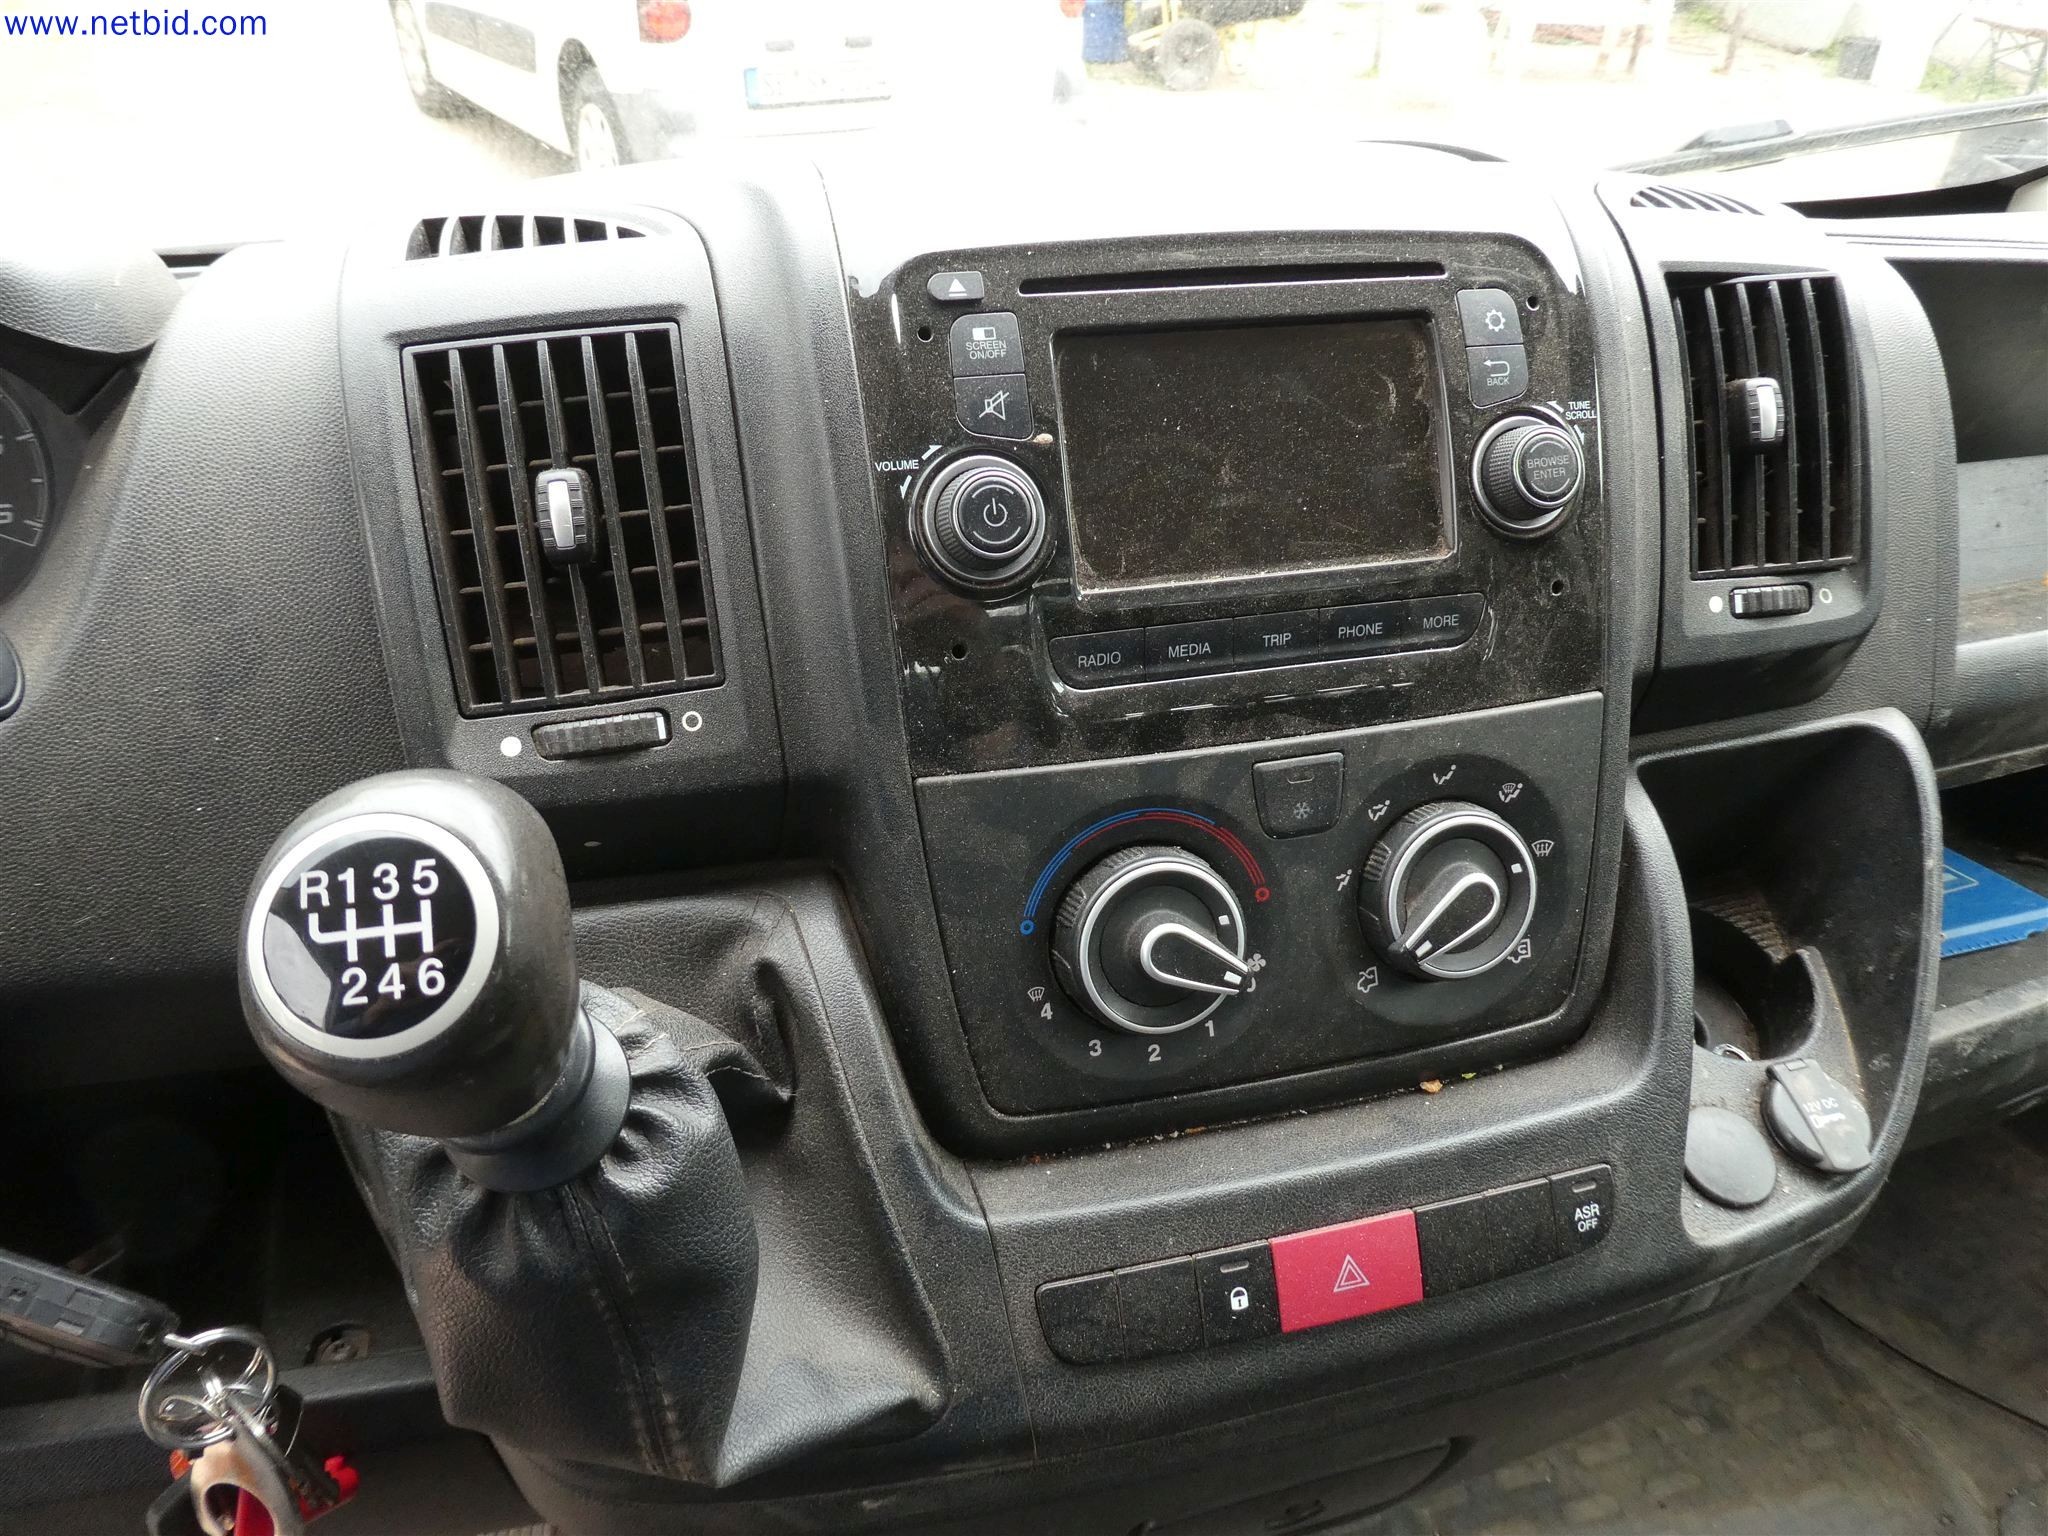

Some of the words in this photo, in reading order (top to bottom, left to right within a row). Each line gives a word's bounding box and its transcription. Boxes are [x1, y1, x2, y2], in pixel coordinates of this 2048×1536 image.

[966, 340, 1007, 351] SCREEN
[969, 349, 1007, 360] ON/OFF
[1486, 376, 1510, 387] BACK
[1567, 400, 1591, 410] TUNE
[1565, 409, 1597, 420] SCROLL
[875, 459, 920, 472] VOLUME
[1526, 454, 1571, 469] BROWSE
[1533, 467, 1567, 480] ENTER
[1422, 613, 1460, 629] MORE
[1337, 621, 1384, 639] PHONE
[1262, 632, 1292, 648] TRIP
[1167, 641, 1212, 659] MEDIA
[1077, 651, 1122, 669] RADIO
[1040, 1002, 1053, 1020] 4
[1204, 1020, 1215, 1037] 1
[1088, 1039, 1102, 1057] 3
[1147, 1044, 1162, 1062] 2
[1574, 1203, 1600, 1221] ASR
[1577, 1217, 1598, 1232] OFF
